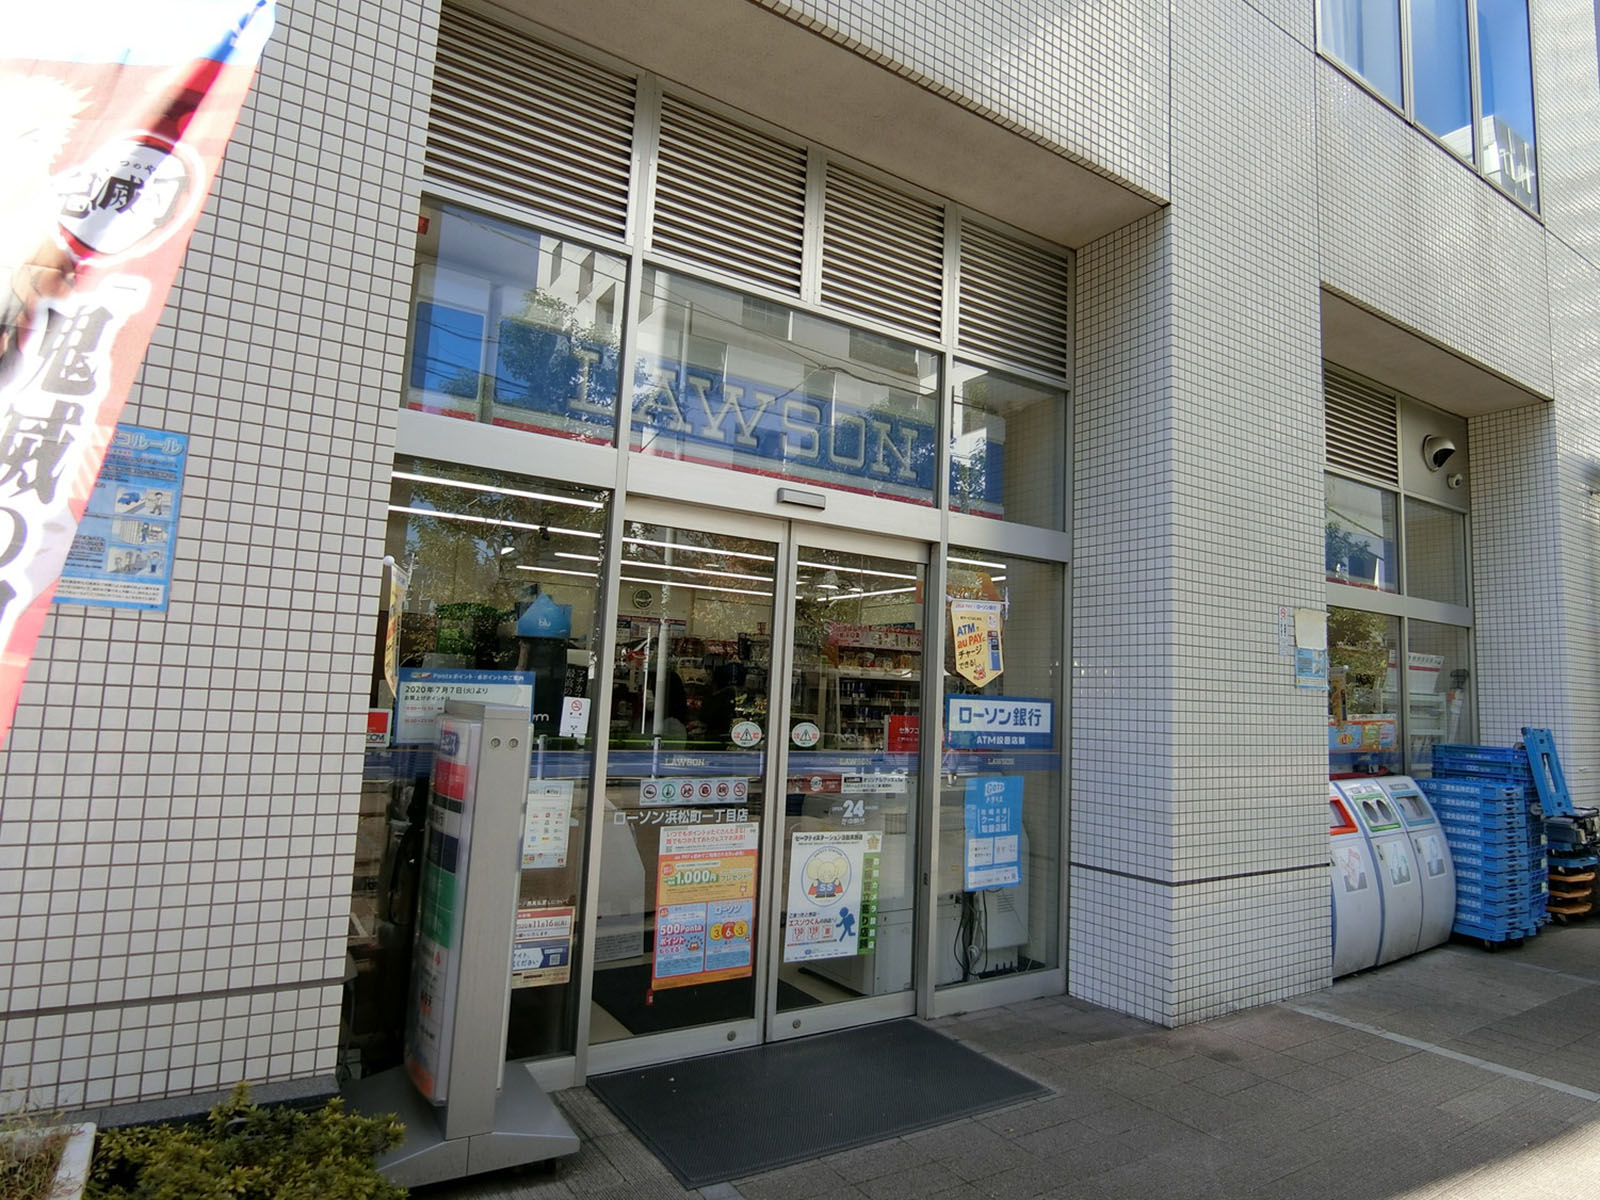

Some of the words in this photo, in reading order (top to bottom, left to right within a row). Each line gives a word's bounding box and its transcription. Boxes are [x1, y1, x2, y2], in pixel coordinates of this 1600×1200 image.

[567, 343, 920, 481] LAWSON
[111, 431, 184, 456] コルール
[957, 640, 968, 649] au
[958, 644, 983, 660] チャージ
[959, 706, 1042, 727] ローソン銀行
[976, 735, 1026, 745] ATM設置店舗
[664, 757, 706, 767] LAWSON
[613, 808, 749, 825] ローソン浜松町一丁目店
[842, 799, 865, 818] 24
[819, 883, 834, 892] SS
